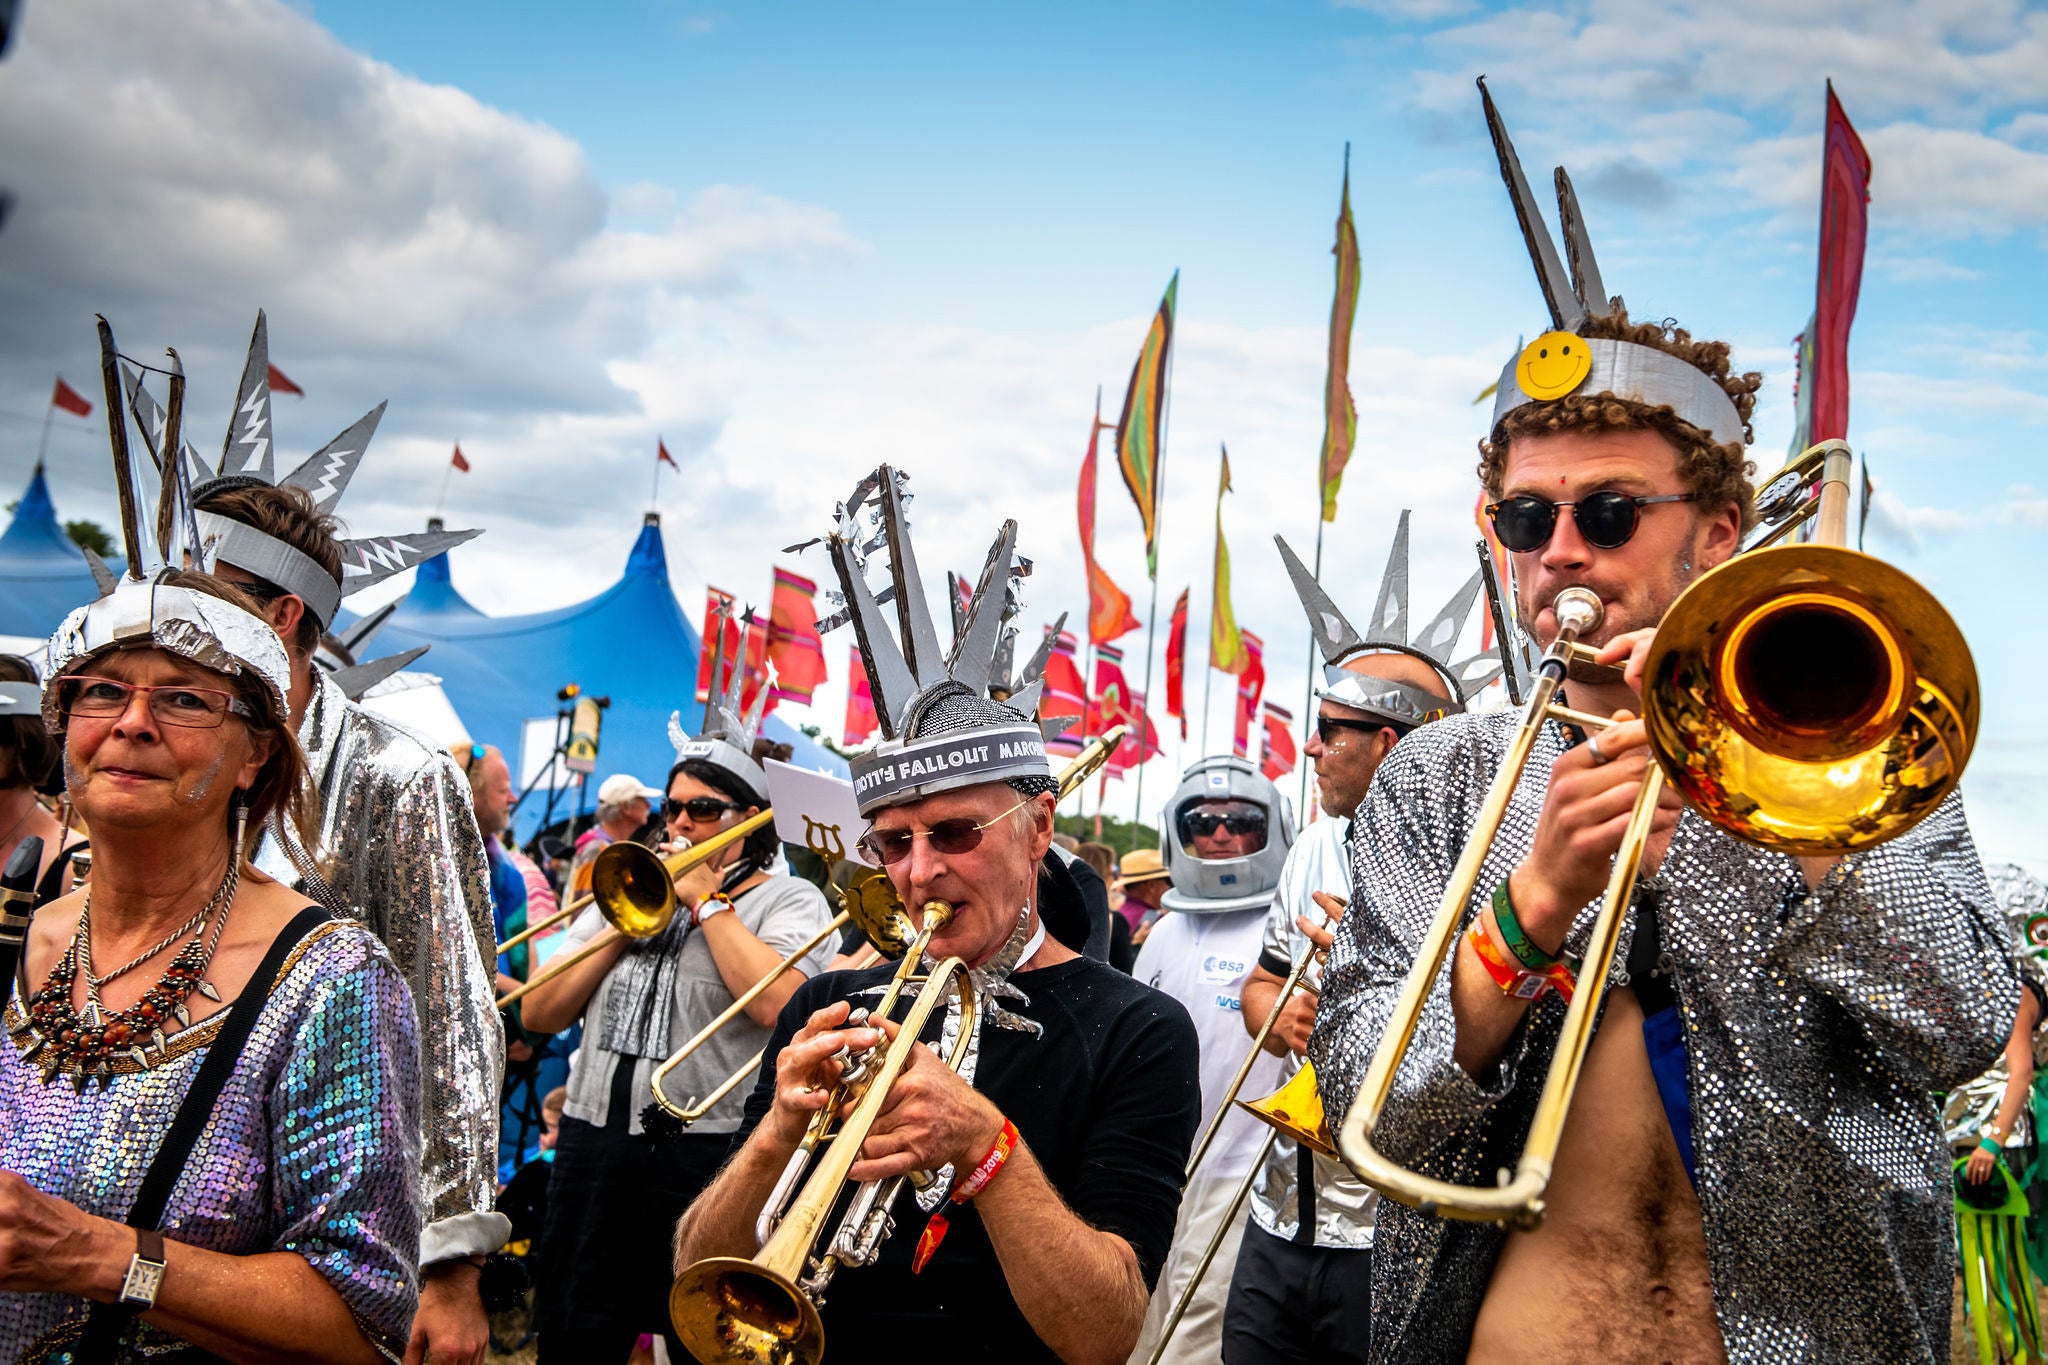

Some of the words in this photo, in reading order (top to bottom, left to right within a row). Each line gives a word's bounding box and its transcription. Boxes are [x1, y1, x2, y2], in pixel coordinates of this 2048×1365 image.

[899, 746, 989, 780] FALLOUT
[999, 741, 1047, 760] MARCH
[1218, 960, 1245, 973] esa
[1216, 995, 1242, 1011] NAS
[983, 1150, 1003, 1174] 2019
